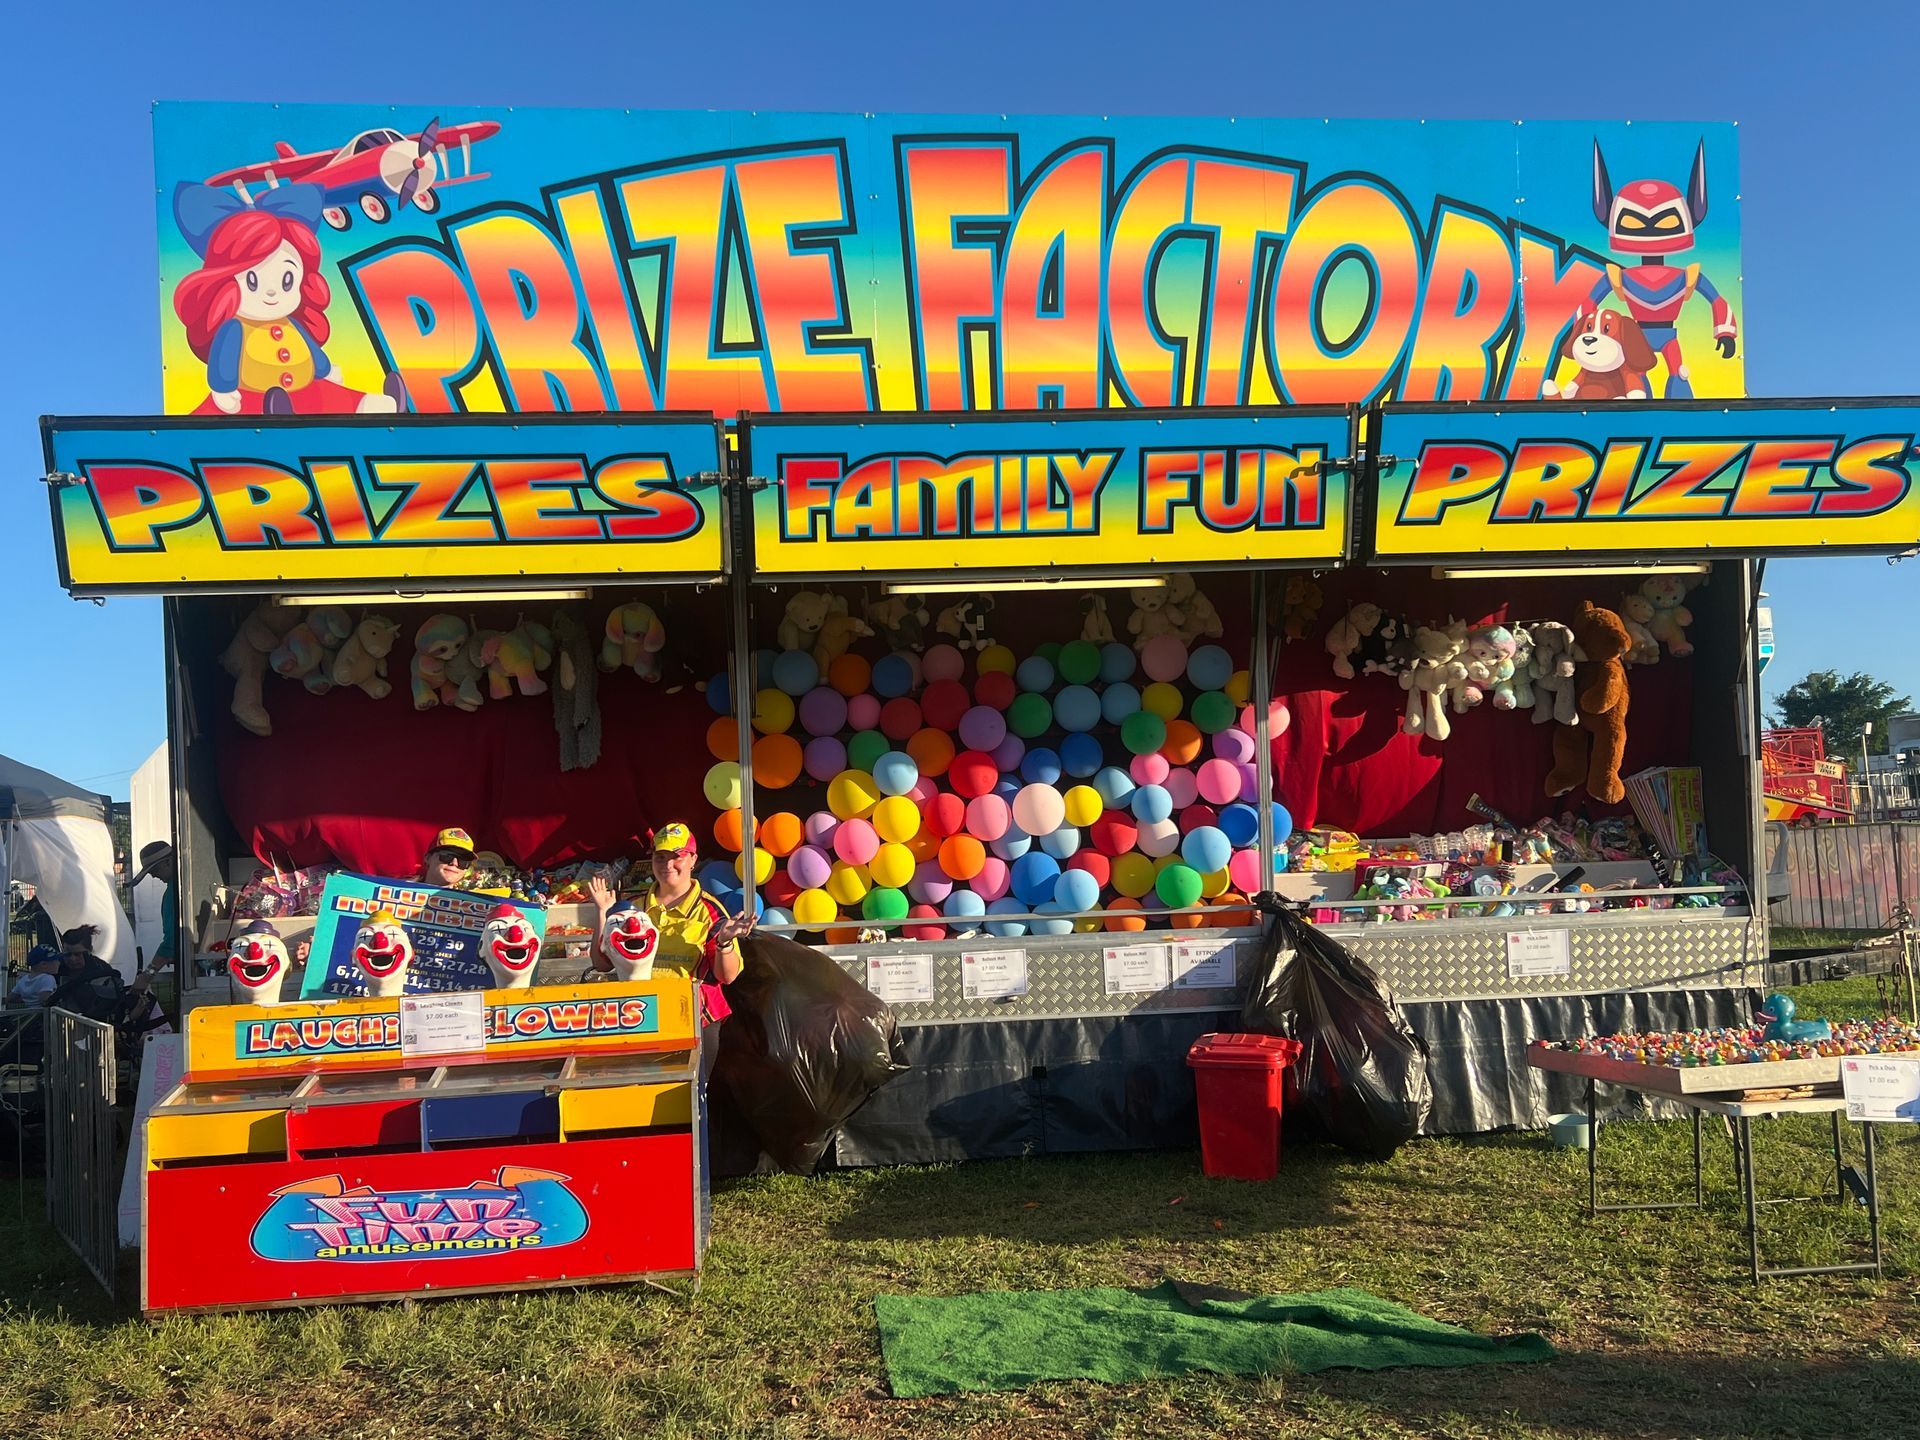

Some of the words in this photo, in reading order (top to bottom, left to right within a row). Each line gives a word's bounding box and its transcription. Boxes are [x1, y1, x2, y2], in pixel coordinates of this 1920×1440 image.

[337, 137, 881, 413] PRIZE
[893, 133, 1622, 409] FACTORY
[777, 447, 1124, 543] FAMILY
[1137, 443, 1329, 535] FUN
[1394, 433, 1917, 526] PRIZES
[77, 452, 706, 553] PRIZES
[335, 895, 487, 932] NUMBE
[377, 886, 492, 915] LUCKY
[417, 934, 439, 949] 29,
[445, 939, 465, 951] 30
[434, 951, 457, 959] SHELF
[432, 971, 455, 980] SHELF
[247, 1016, 401, 1053] LAUGHI
[1868, 1076, 1885, 1084] $7.00
[308, 1195, 516, 1225] Fun
[287, 1219, 543, 1248] Time
[315, 1234, 544, 1258] amusements
